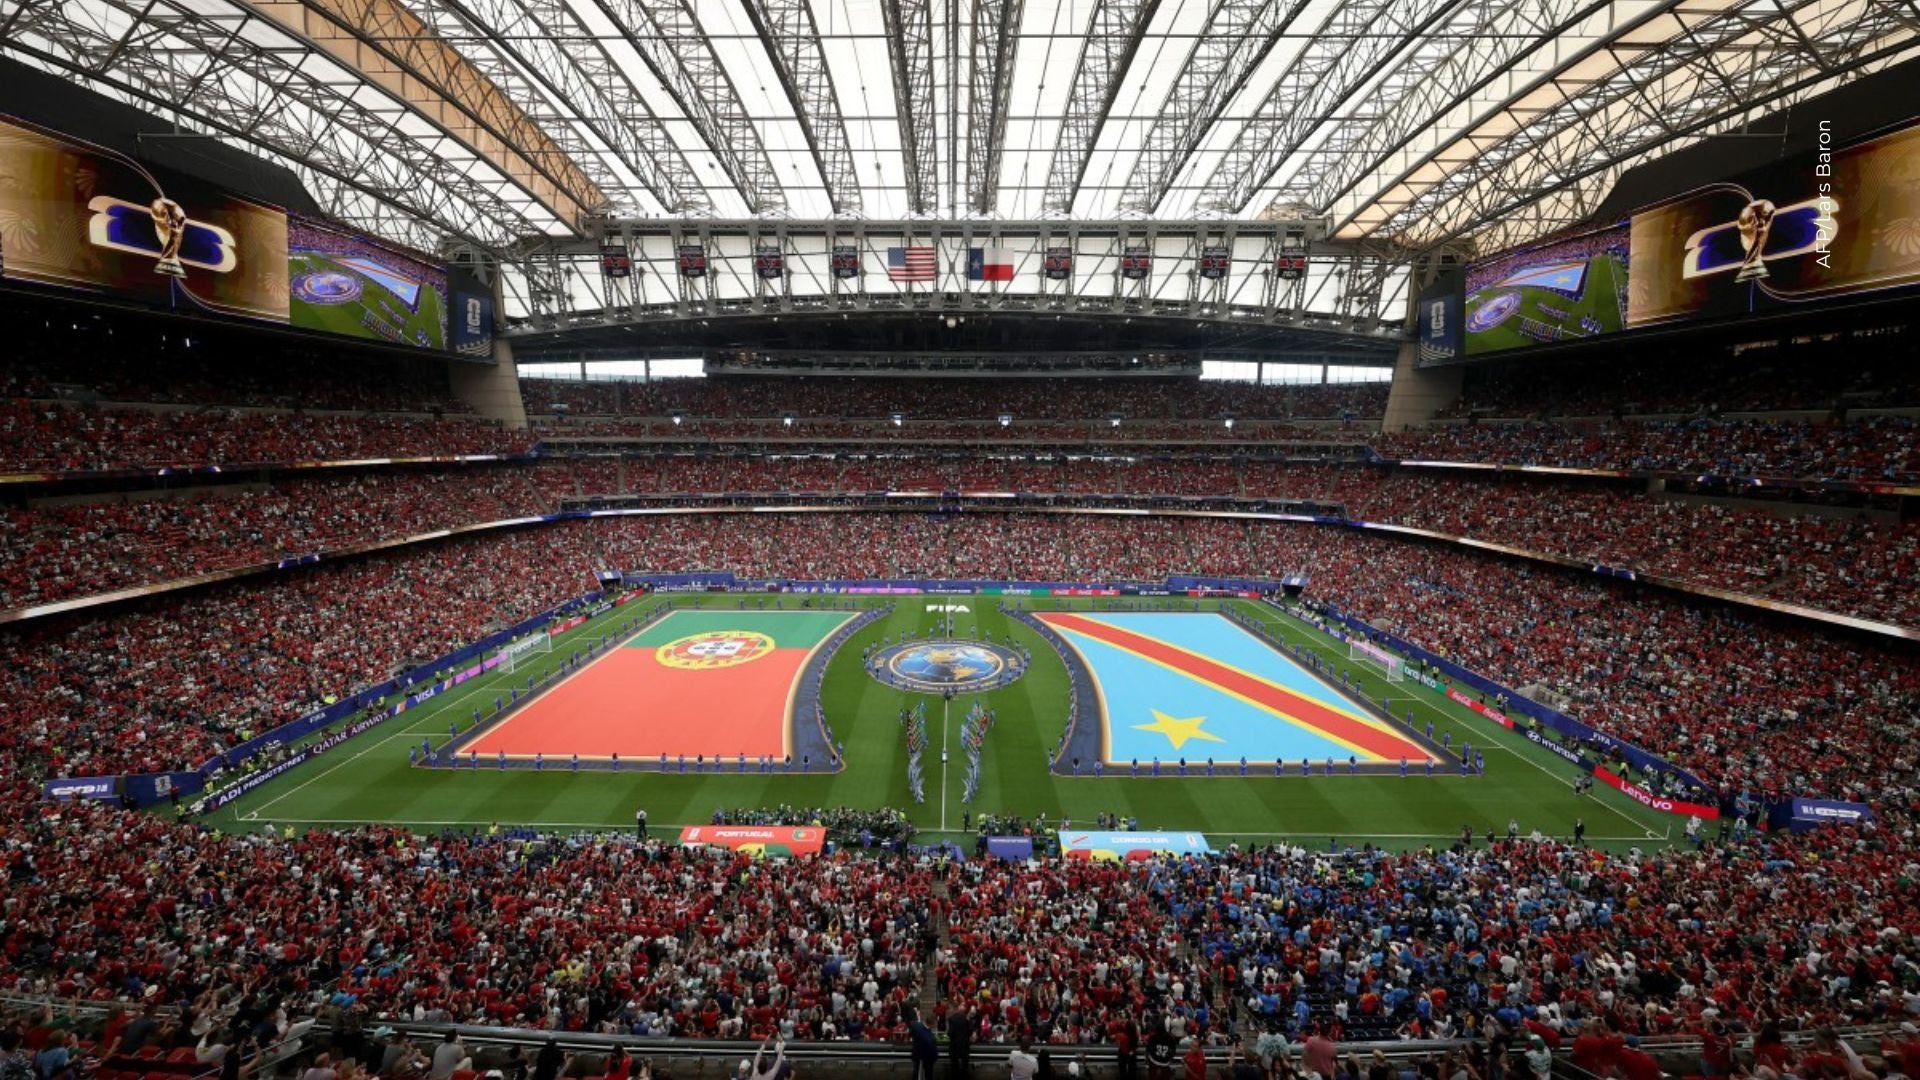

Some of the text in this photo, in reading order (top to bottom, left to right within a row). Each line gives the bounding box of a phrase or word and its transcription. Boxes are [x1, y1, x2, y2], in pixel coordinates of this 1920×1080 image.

[926, 605, 970, 613] FIFA
[415, 688, 435, 703] VISA
[313, 711, 389, 754] QATAR AIRWAYS
[1593, 731, 1611, 746] FIFA
[1541, 739, 1580, 764] HYUNDAI
[219, 753, 306, 805] ADI PREDICTSTREET
[1620, 780, 1673, 810] Lenovo
[715, 830, 775, 838] PORTUGAL
